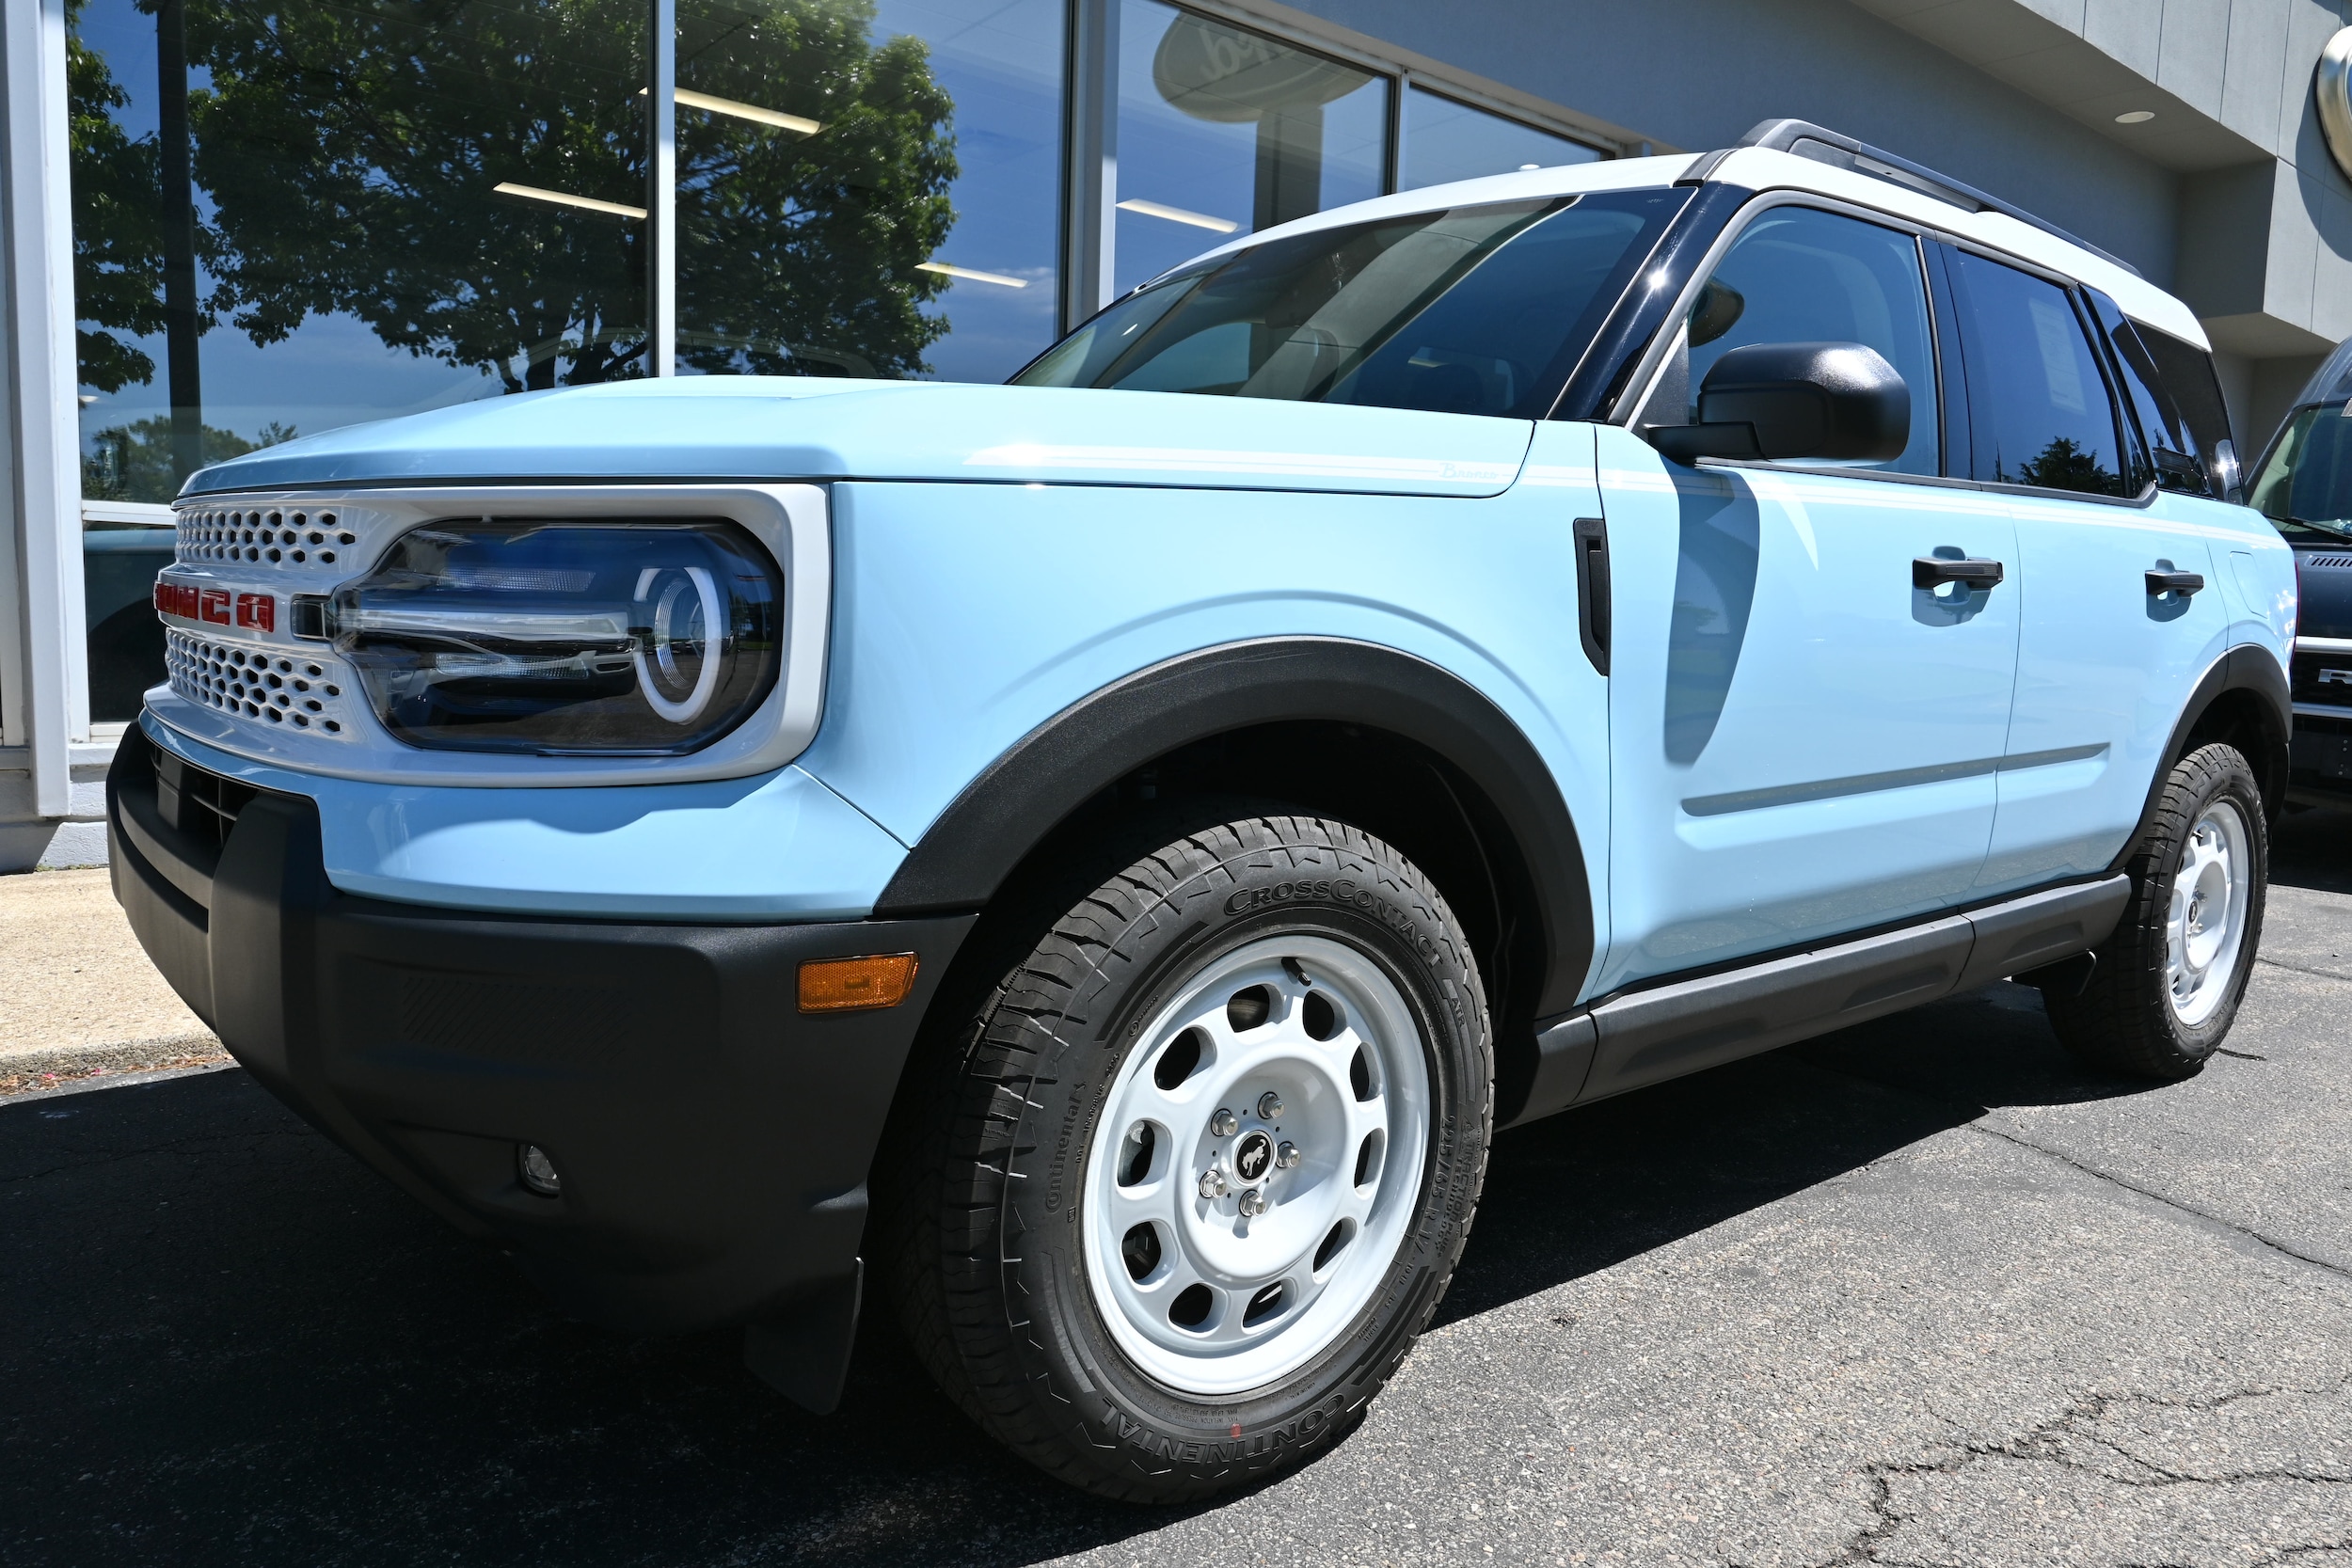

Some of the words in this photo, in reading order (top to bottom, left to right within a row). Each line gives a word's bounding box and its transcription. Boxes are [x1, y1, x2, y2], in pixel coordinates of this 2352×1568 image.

[1438, 462, 1498, 481] Bronco
[153, 580, 275, 633] ONCO
[1450, 995, 1467, 1028] ATR
[1045, 1097, 1083, 1214] Continental
[1102, 1394, 1345, 1465] CONTINENTAL
